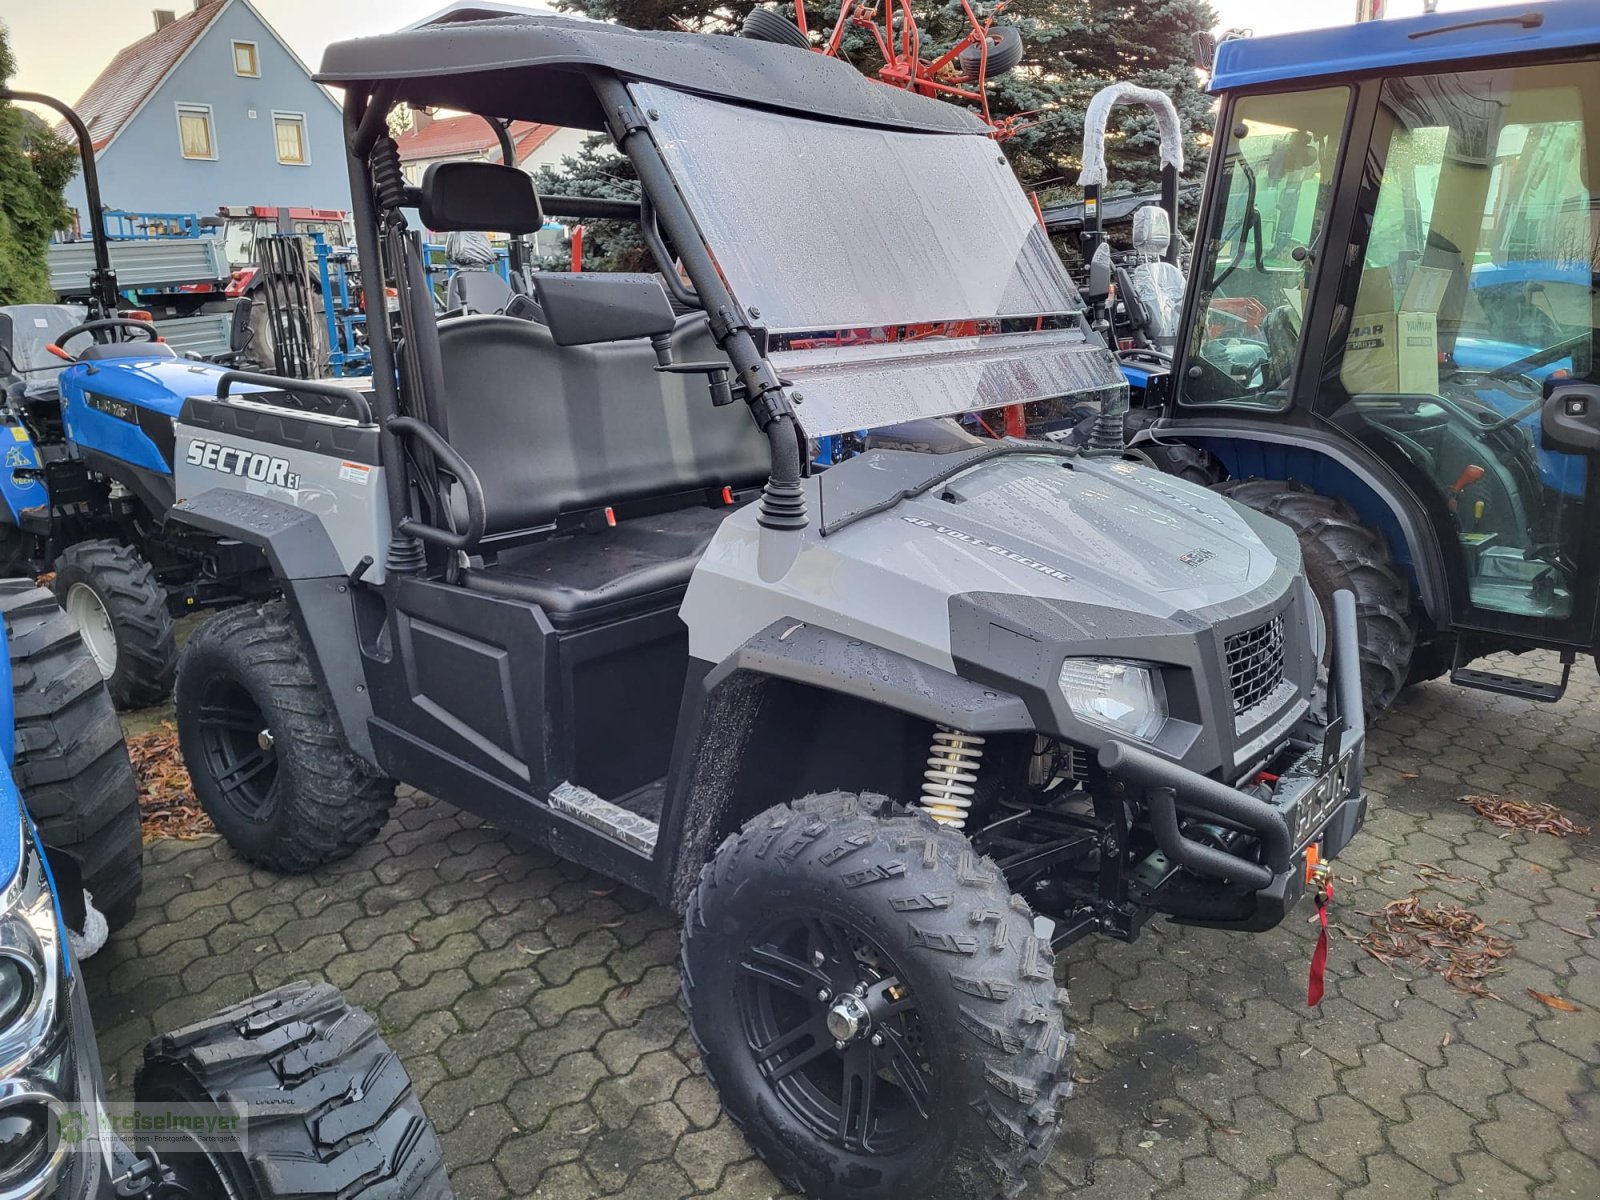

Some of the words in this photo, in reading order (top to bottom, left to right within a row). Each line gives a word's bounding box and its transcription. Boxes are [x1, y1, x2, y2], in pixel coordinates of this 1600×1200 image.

[186, 438, 290, 488] SECTOR
[287, 472, 301, 490] E1
[901, 516, 933, 528] 48
[935, 525, 986, 547] VOLT
[987, 545, 1076, 583] ELECTRIC
